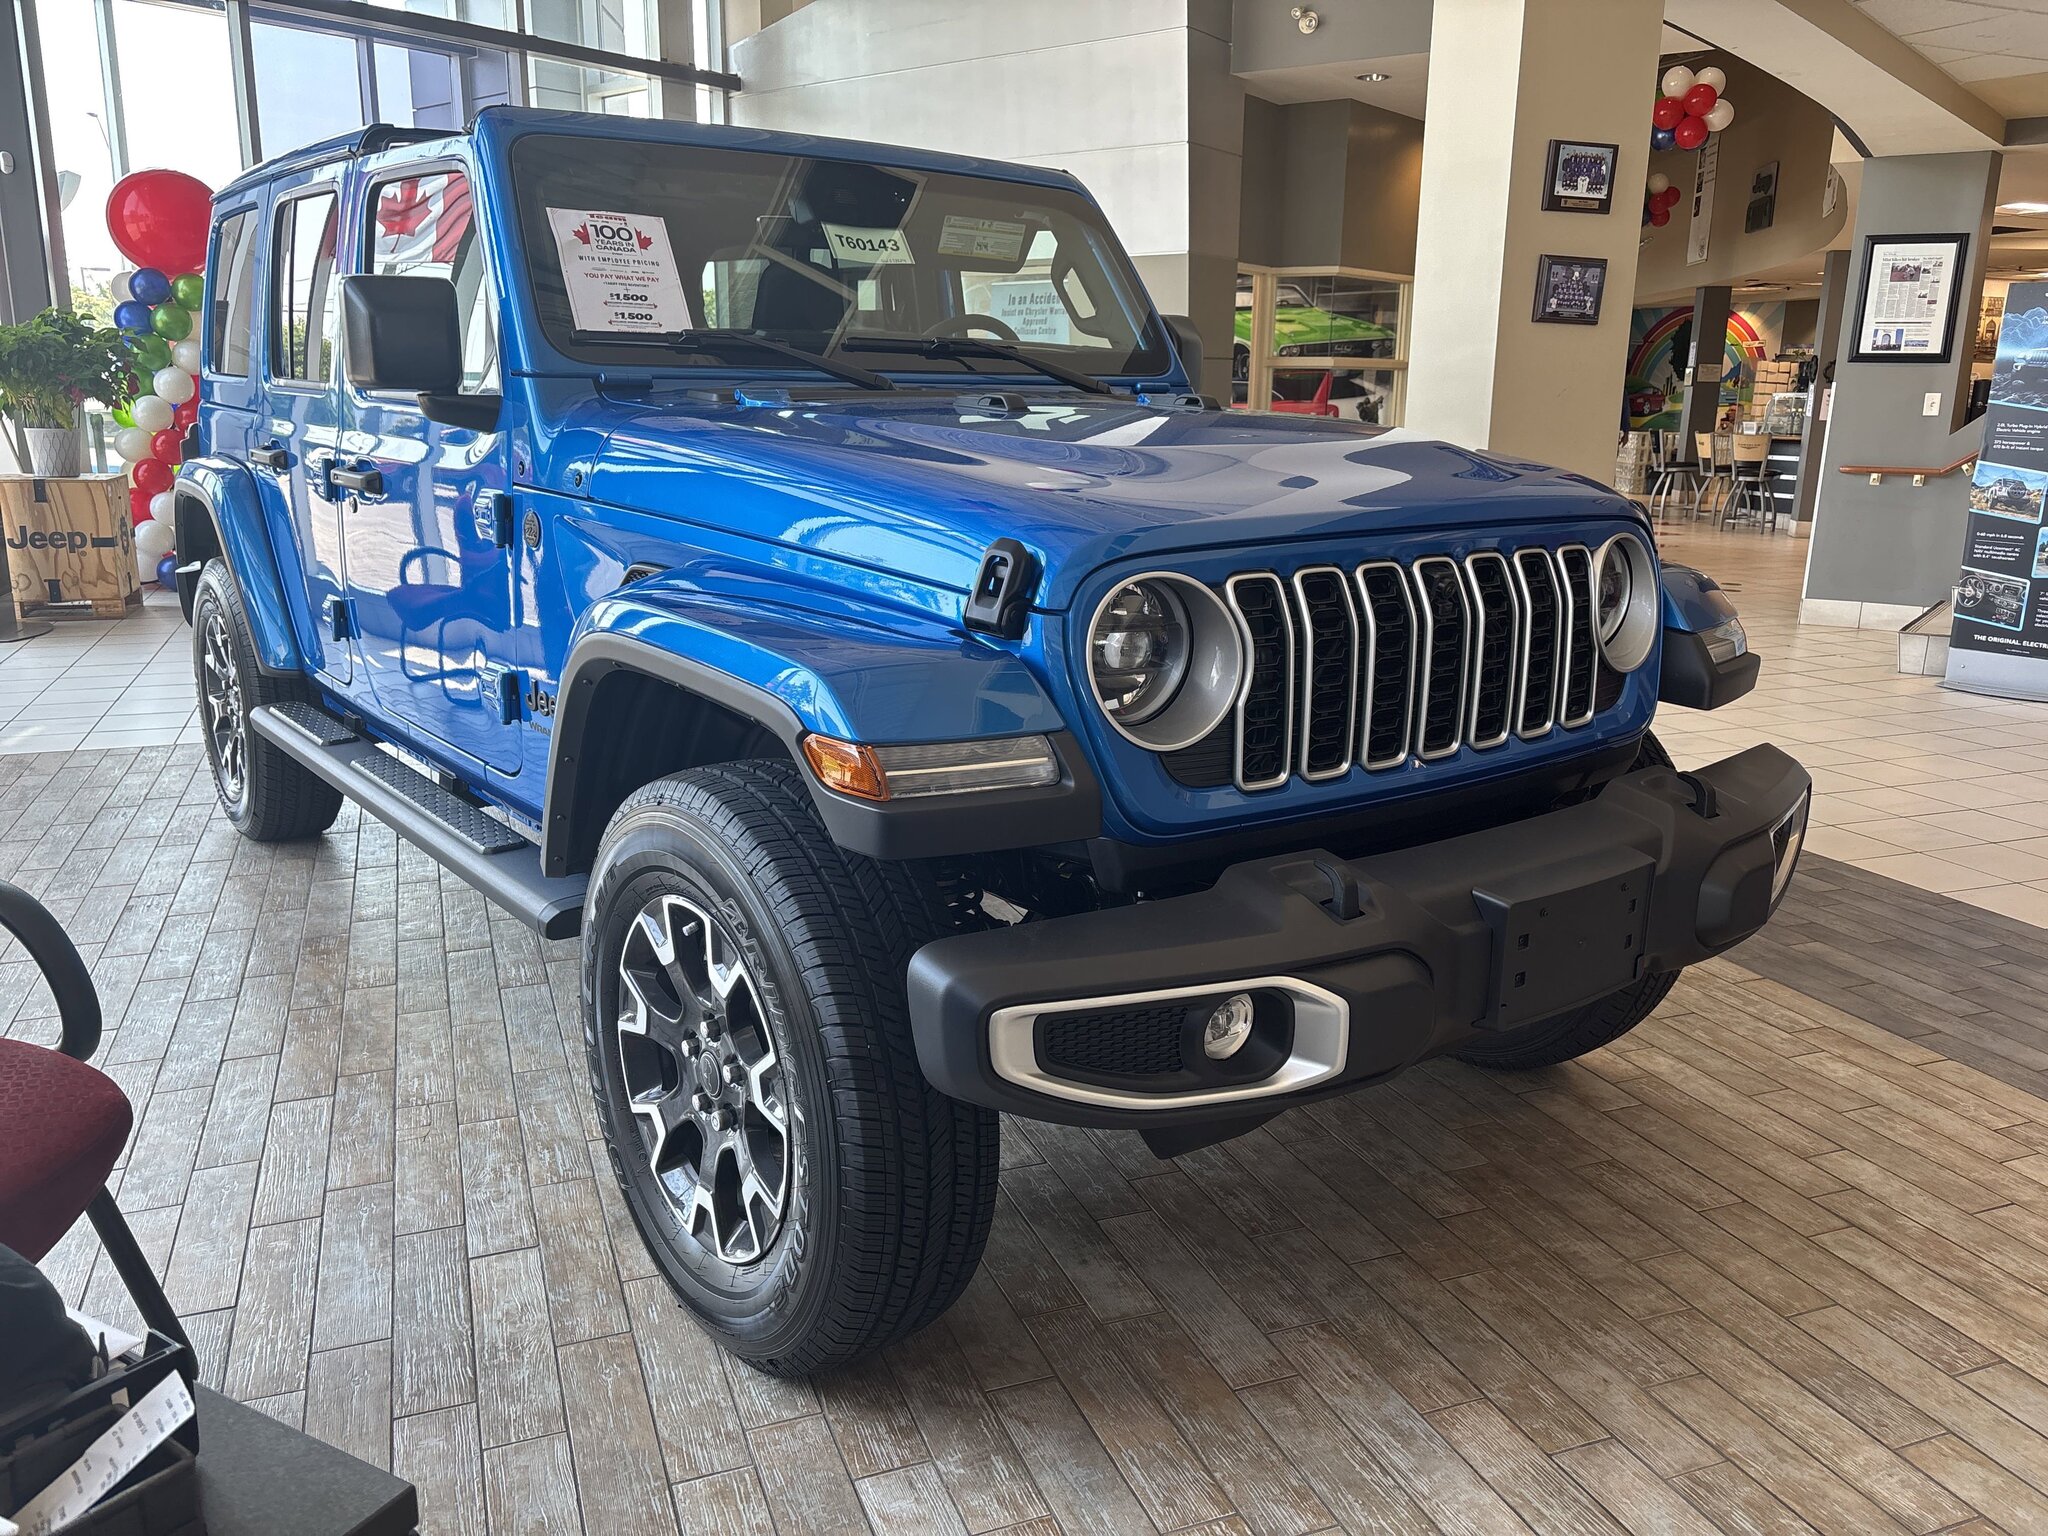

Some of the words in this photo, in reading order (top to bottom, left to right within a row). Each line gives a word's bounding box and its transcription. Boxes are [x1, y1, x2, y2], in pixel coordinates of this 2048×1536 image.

[589, 224, 633, 242] 100
[594, 238, 624, 247] YEARS
[625, 240, 635, 248] IN
[595, 244, 637, 253] CANADA
[834, 233, 900, 252] T60143
[577, 254, 596, 262] WITH
[597, 256, 631, 265] EMPLOYEE
[632, 259, 661, 267] PRICING
[609, 292, 648, 302] $1,500
[1008, 293, 1016, 306] In
[1017, 295, 1028, 305] an
[614, 311, 653, 321] $1,500
[6, 525, 88, 554] Jeep
[526, 679, 557, 717] Jee
[529, 720, 552, 737] WRAN
[719, 897, 811, 1312] BRIDGESTONE
